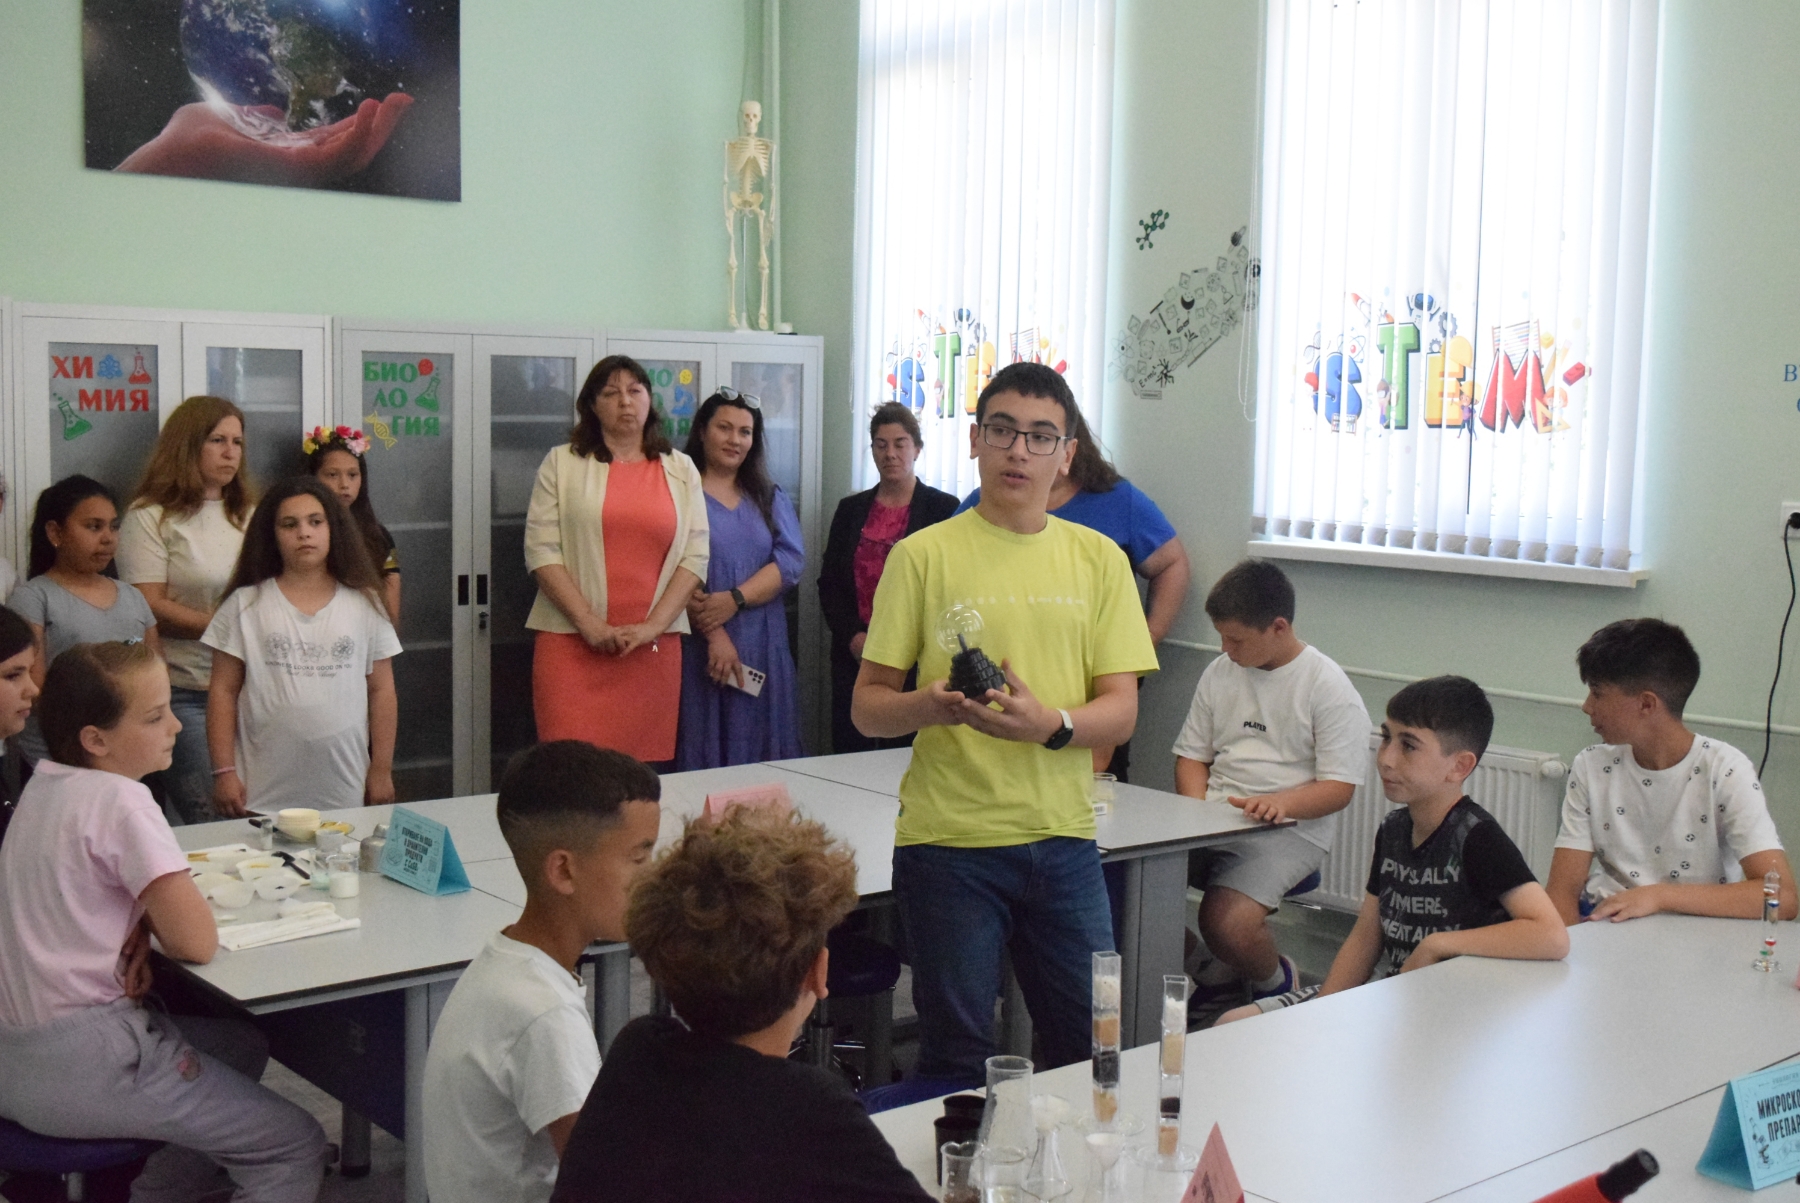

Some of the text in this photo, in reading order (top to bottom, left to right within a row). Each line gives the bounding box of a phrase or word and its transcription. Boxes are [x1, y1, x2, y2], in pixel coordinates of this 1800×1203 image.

[51, 355, 93, 379] ХИ
[364, 361, 418, 383] БИО
[893, 331, 1042, 418] STE
[1312, 322, 1553, 433] STEM
[78, 388, 149, 412] МИЯ
[372, 387, 408, 408] ЛО
[392, 415, 439, 436] ГИЯ
[1243, 721, 1267, 732] PLAYER
